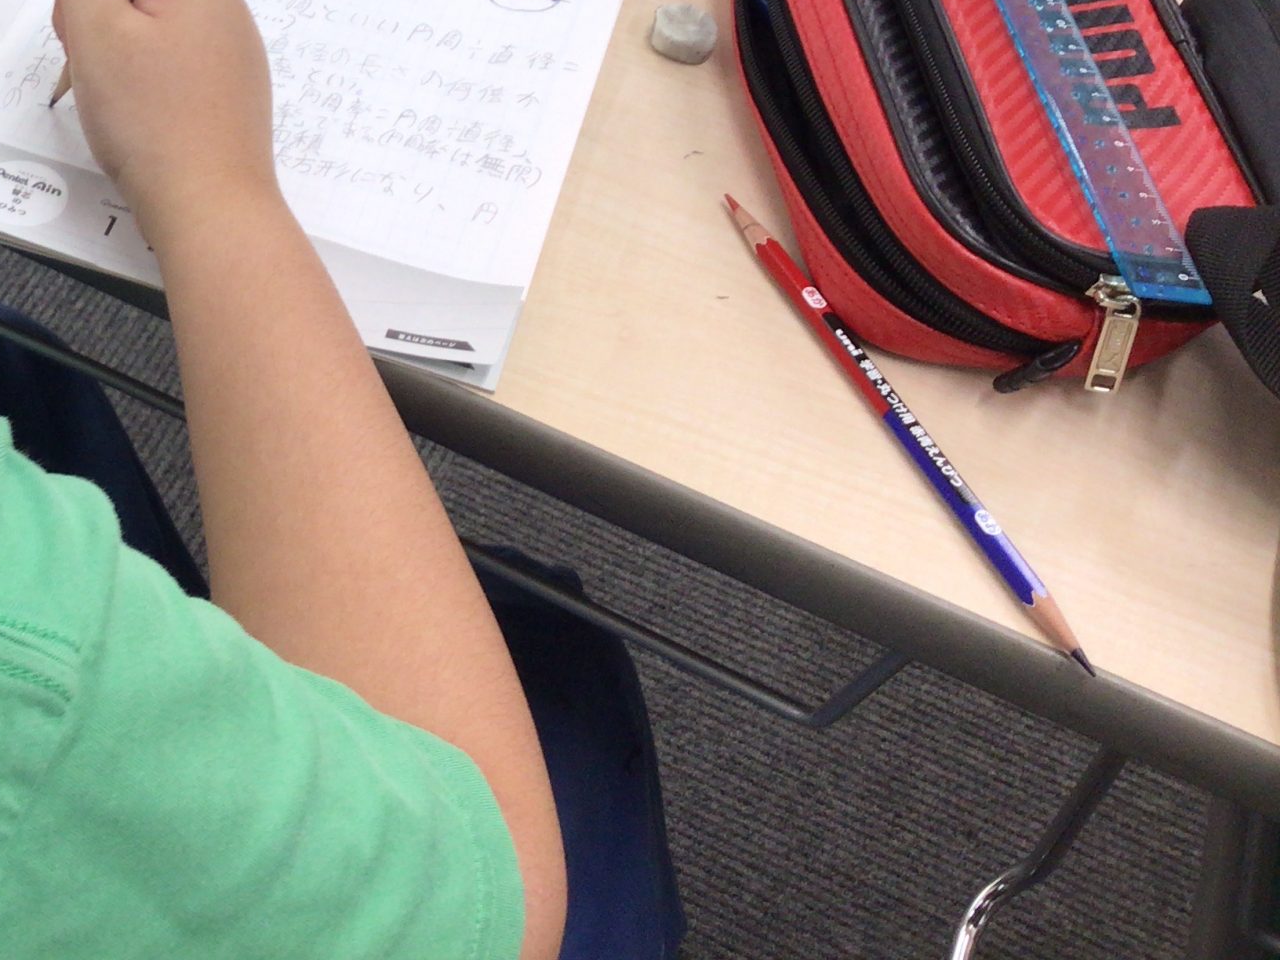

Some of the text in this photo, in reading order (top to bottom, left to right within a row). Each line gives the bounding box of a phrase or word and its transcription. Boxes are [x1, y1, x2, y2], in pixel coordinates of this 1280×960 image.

[31, 181, 63, 198] Ain
[103, 214, 118, 237] 1
[835, 328, 863, 357] uni
[909, 425, 964, 488] 赤青えんぴつ
